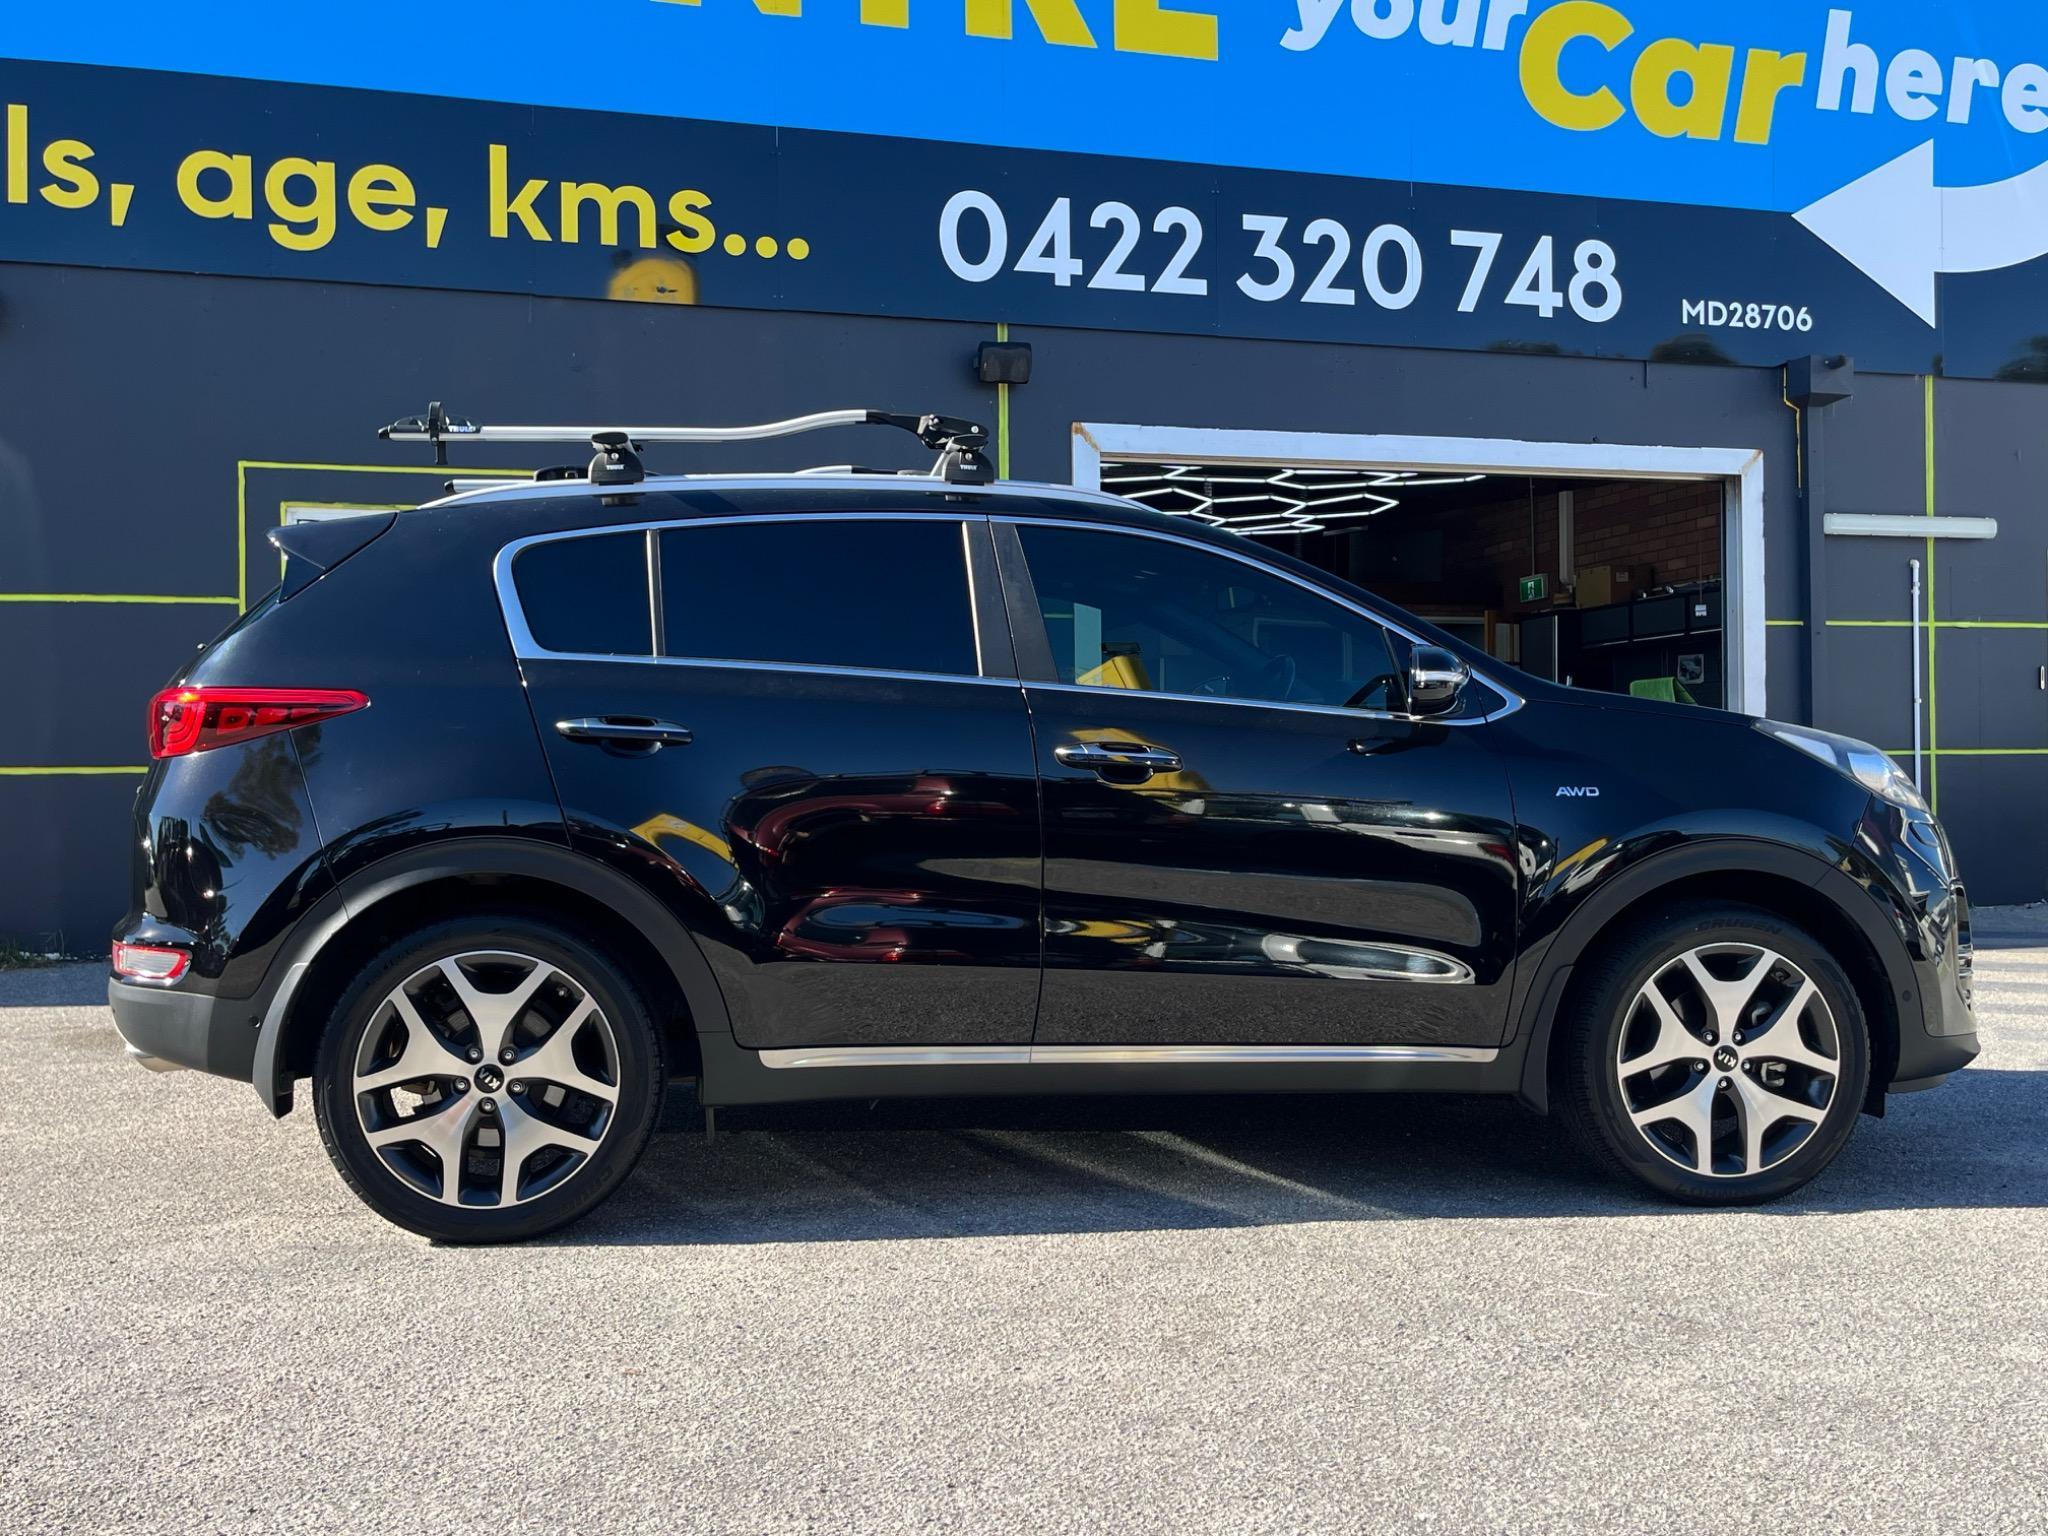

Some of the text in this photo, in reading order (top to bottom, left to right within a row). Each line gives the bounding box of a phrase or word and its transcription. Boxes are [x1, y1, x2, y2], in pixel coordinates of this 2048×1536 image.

[1279, 0, 1528, 51] your
[1519, 1, 1805, 144] Car
[1816, 9, 2048, 133] here
[177, 150, 447, 250] age,
[489, 144, 810, 260] kms...
[940, 190, 1622, 323] 0422 320 748
[1682, 298, 1813, 332] MD28706
[1555, 786, 1600, 797] AWD
[1717, 1049, 1737, 1068] KIA
[479, 1067, 501, 1090] KIA
